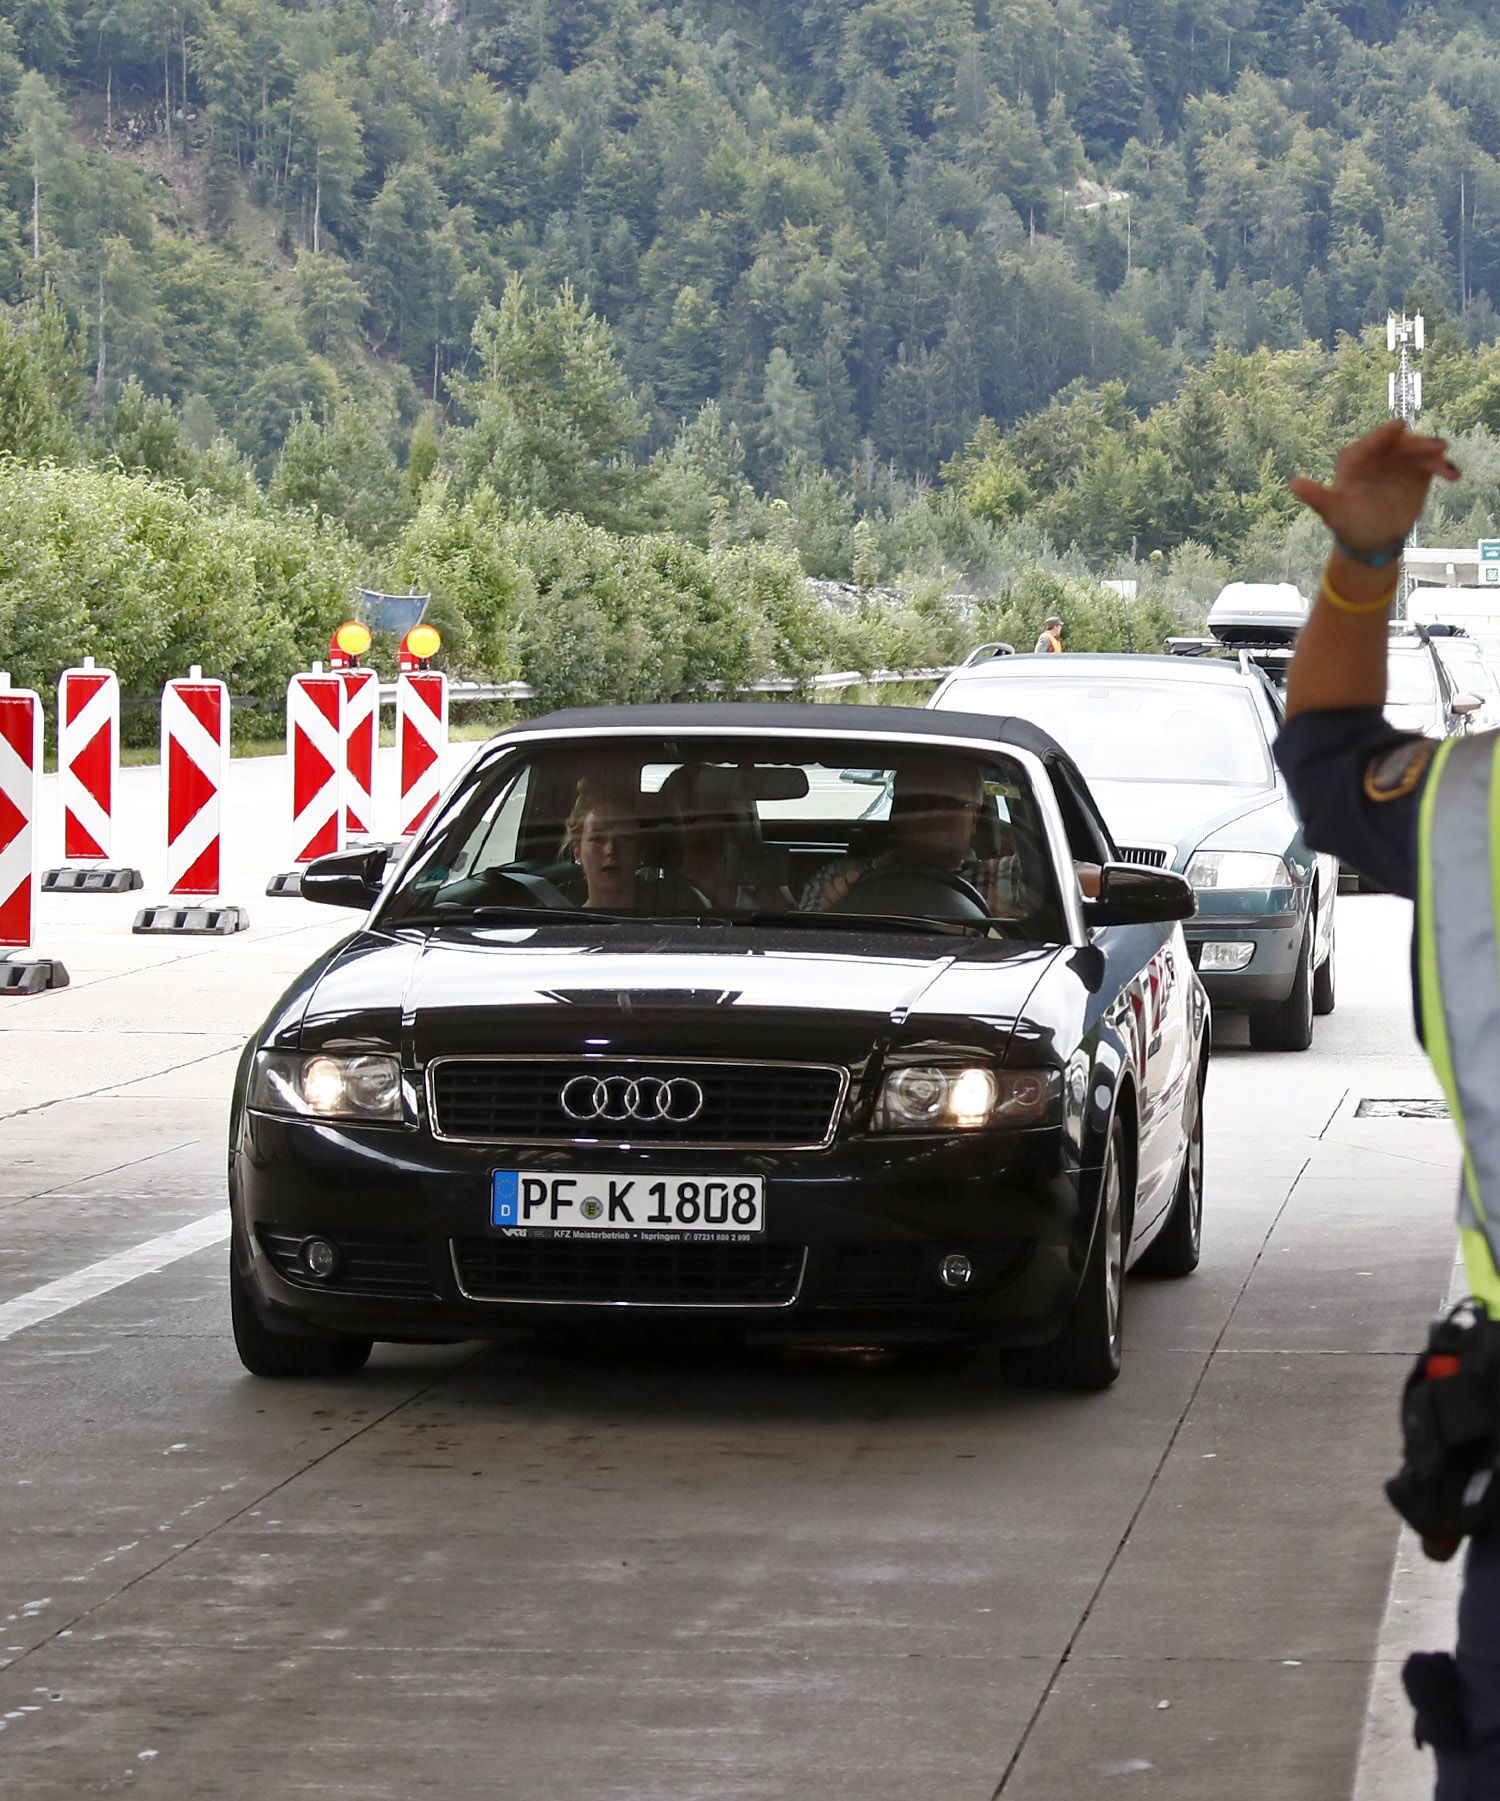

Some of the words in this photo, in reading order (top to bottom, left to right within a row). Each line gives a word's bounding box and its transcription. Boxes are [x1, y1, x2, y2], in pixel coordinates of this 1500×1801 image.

[521, 1179, 577, 1220] PF
[608, 1181, 636, 1222] K
[647, 1182, 757, 1225] 1808
[501, 1204, 511, 1217] D
[554, 1230, 572, 1239] KFZ
[572, 1230, 630, 1240] Meisterbetrieb
[641, 1232, 680, 1242] Ispringen
